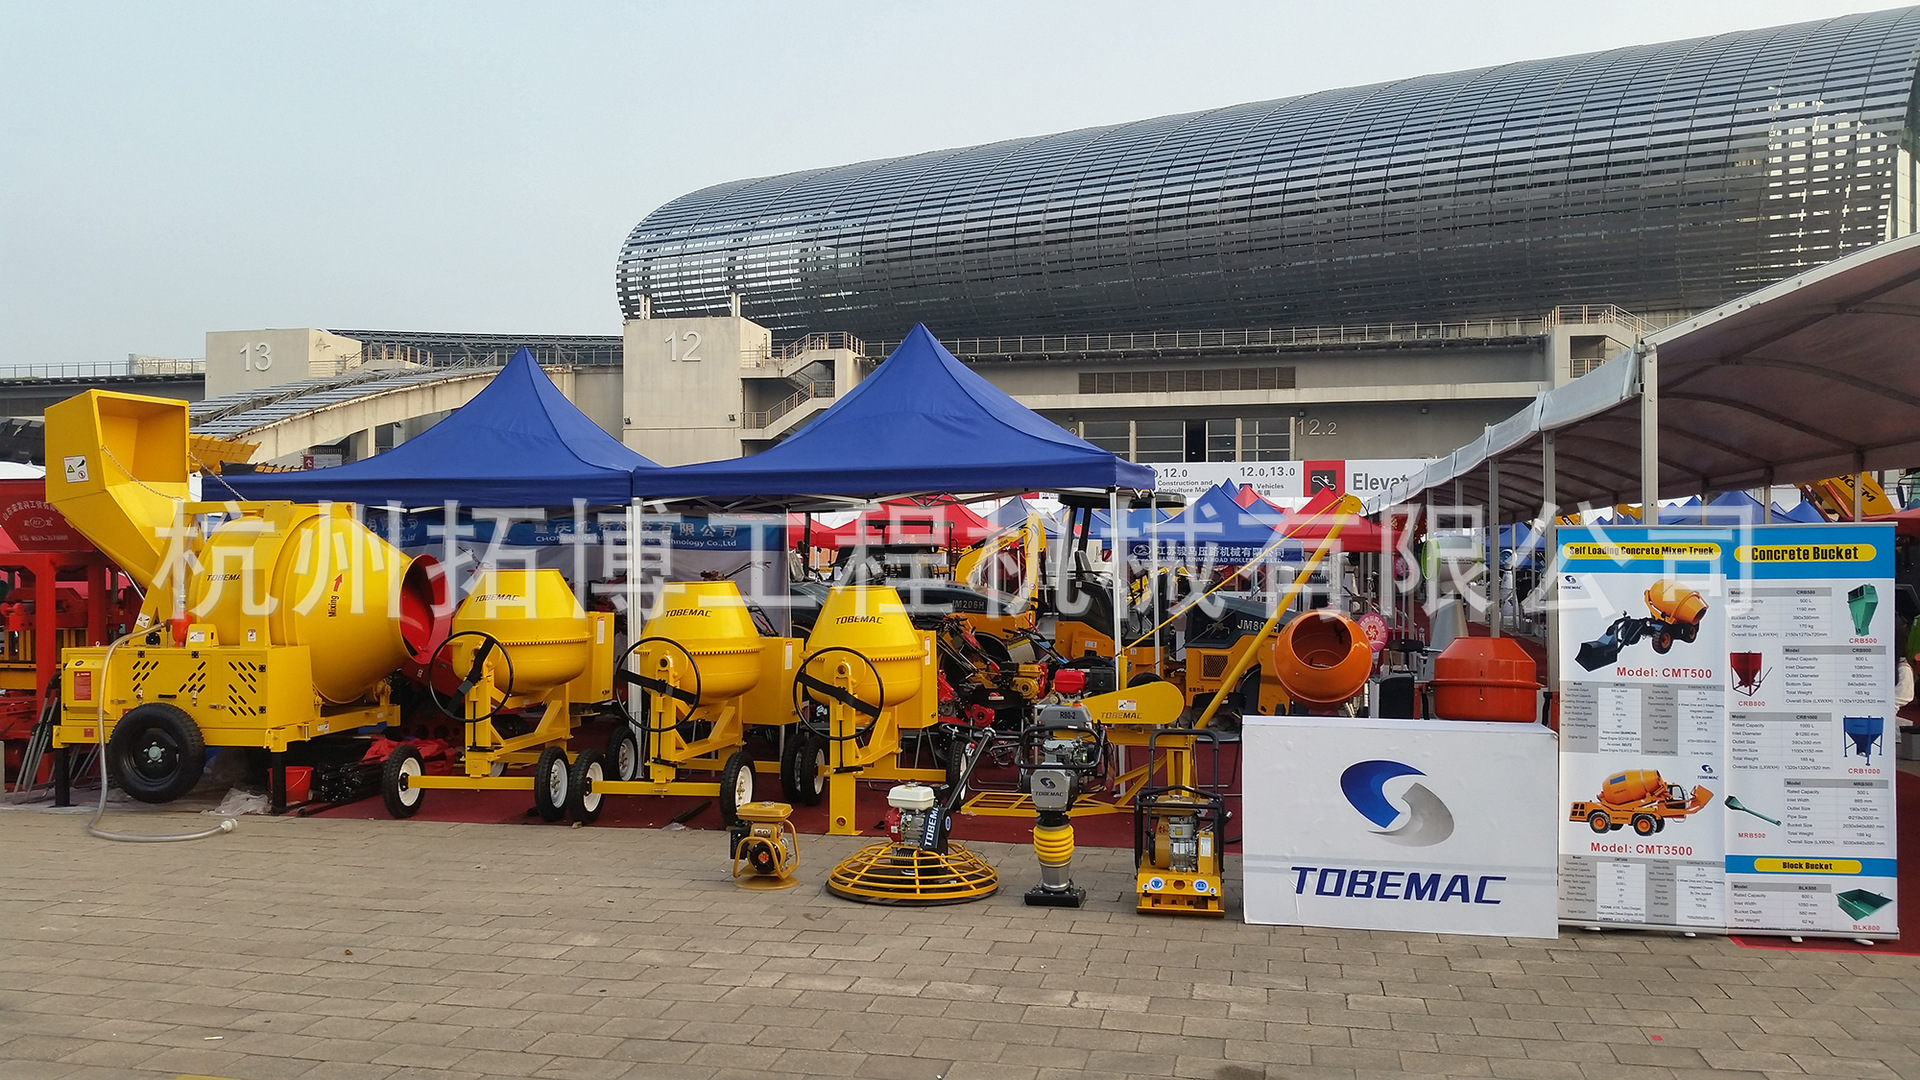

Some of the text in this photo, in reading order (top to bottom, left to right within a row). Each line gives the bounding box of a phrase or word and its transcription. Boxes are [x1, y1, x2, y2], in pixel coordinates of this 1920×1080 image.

[664, 330, 702, 362] 12
[240, 342, 272, 372] 13
[1296, 419, 1336, 436] 12.2
[1570, 546, 1714, 556] Self Loading Concrete Mixer Truck
[1752, 546, 1858, 560] Concrete Bucket
[328, 595, 339, 618] Mixing
[665, 608, 712, 618] TOBEMAC
[835, 616, 884, 625] TOBEMAC
[1616, 667, 1712, 678] Model: CMT500
[1590, 842, 1693, 856] Model: CMT3500
[1290, 866, 1506, 905] TOBEMAC
